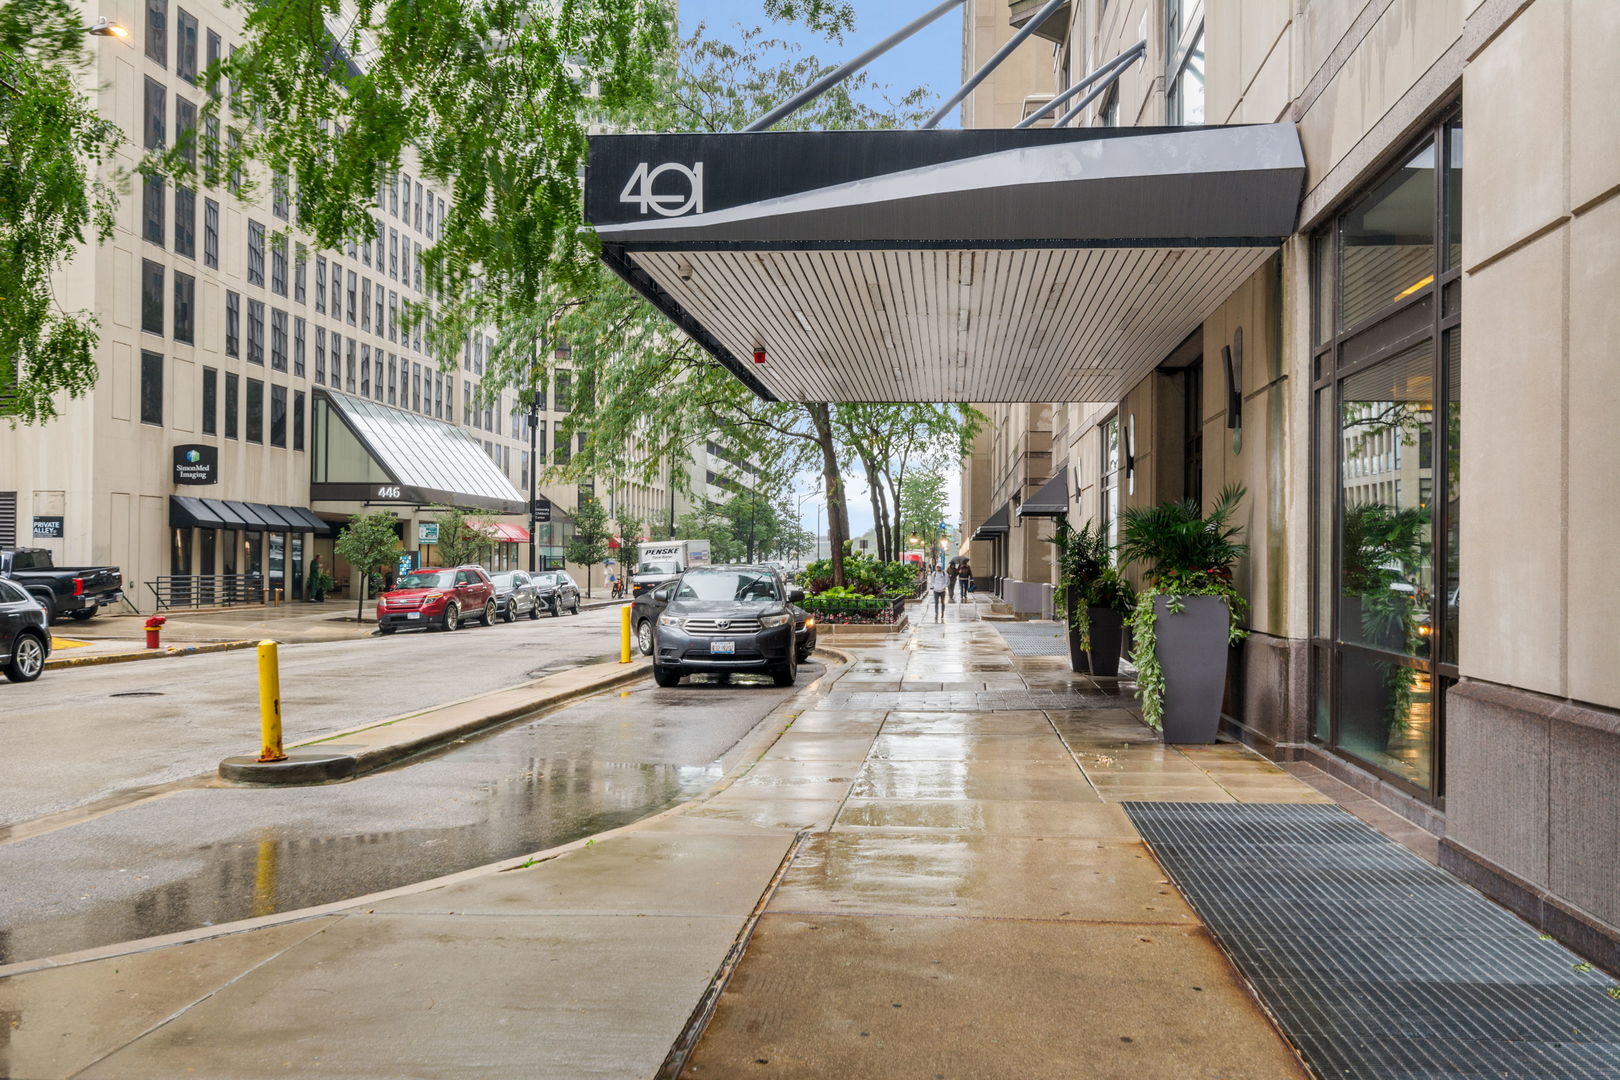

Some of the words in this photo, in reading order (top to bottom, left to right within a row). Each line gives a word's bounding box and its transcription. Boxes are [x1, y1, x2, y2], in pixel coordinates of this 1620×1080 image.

[620, 162, 703, 217] 401
[180, 471, 207, 480] Imaging
[378, 486, 400, 498] 446
[645, 547, 679, 555] PENSKE
